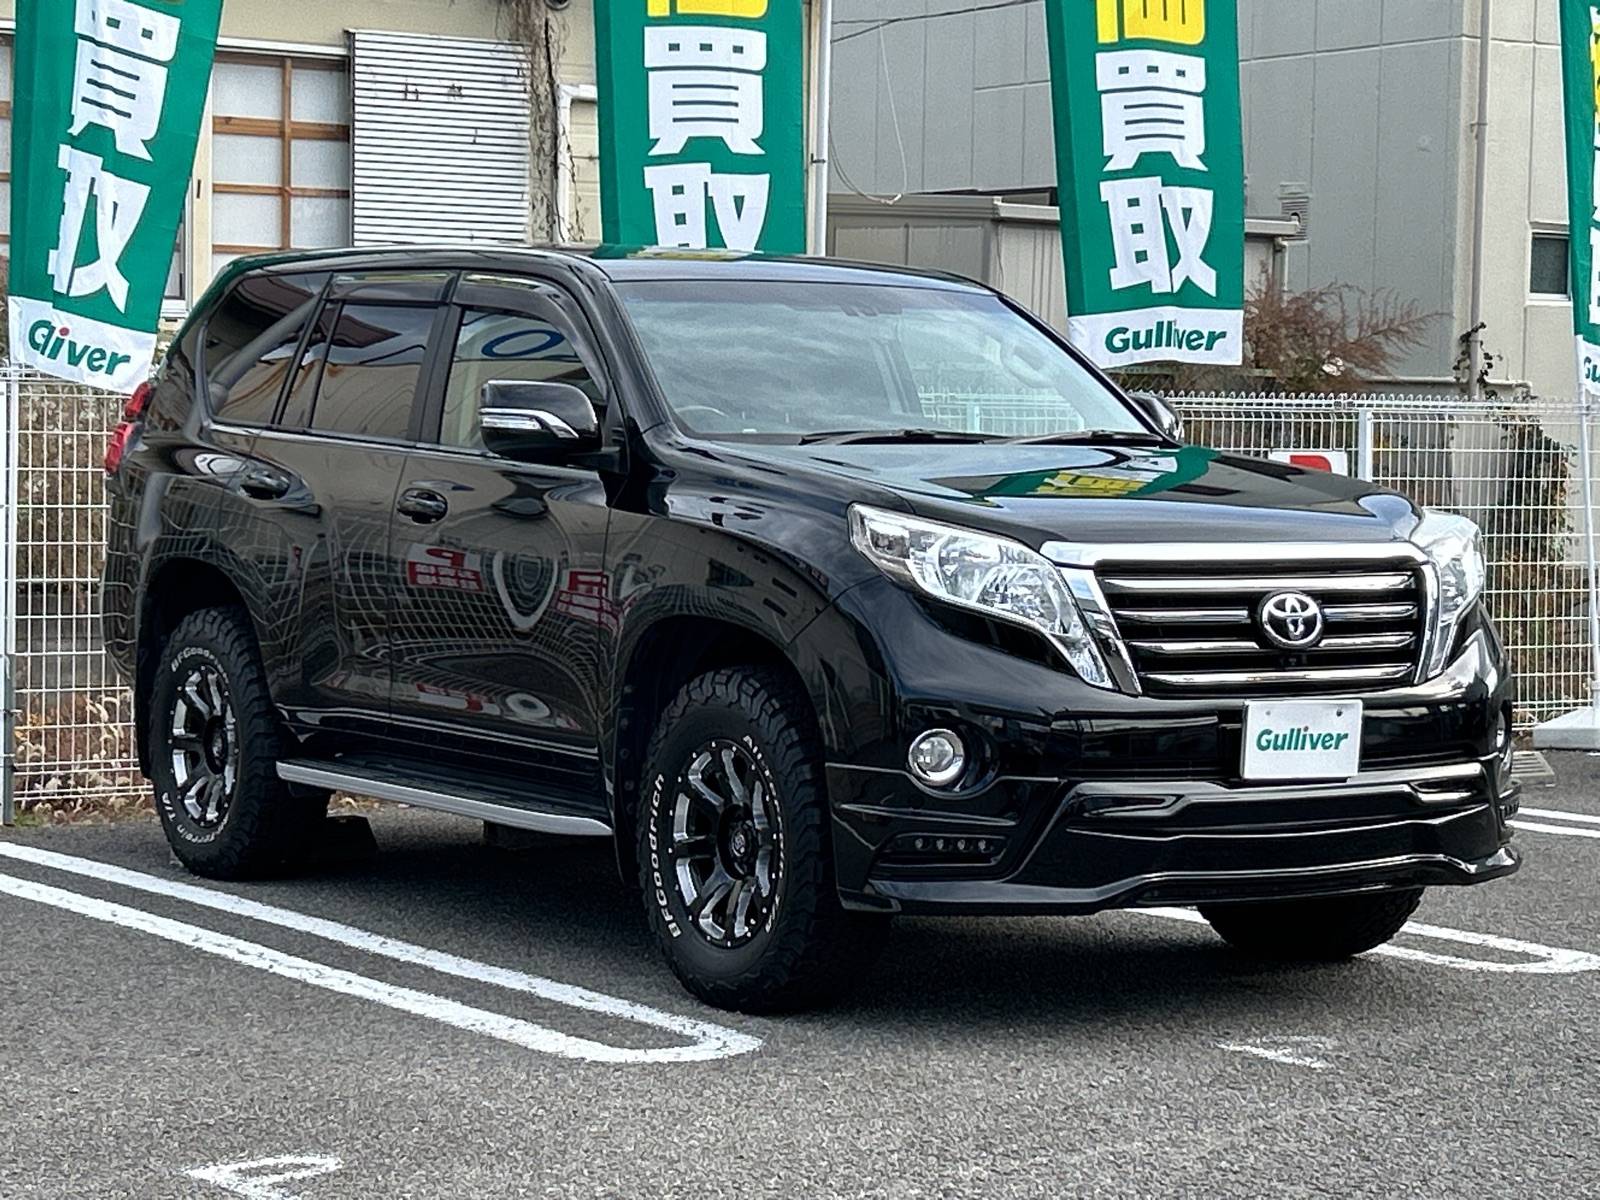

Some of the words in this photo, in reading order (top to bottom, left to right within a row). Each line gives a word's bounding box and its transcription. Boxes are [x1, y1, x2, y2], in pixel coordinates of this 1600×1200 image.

[643, 0, 770, 251] 買取
[1256, 726, 1349, 751] Gulliver
[649, 774, 682, 938] BFGoodrich
